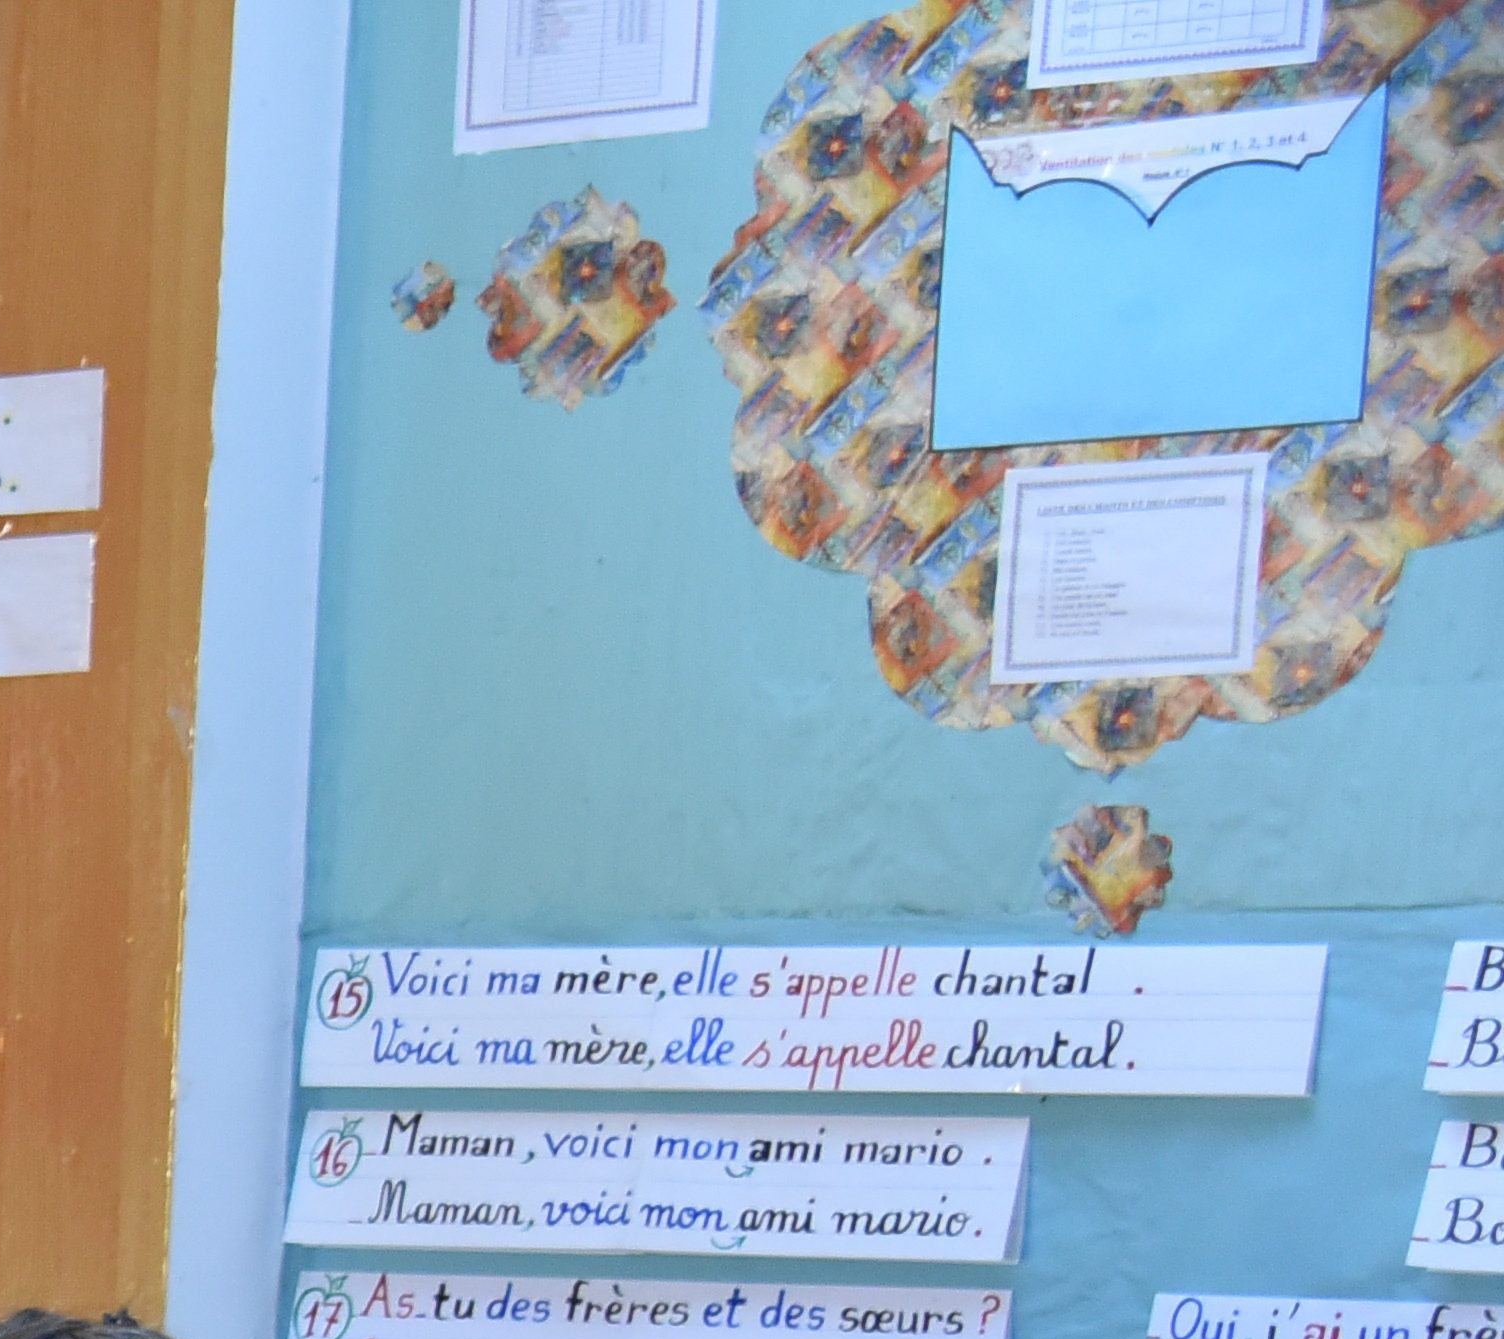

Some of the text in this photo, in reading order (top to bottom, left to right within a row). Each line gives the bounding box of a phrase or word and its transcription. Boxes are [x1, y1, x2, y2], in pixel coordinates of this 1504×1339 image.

[381, 951, 472, 996] Voici
[486, 972, 541, 995] ma
[672, 949, 739, 997] elle
[326, 980, 367, 1020] 15
[372, 1017, 460, 1066] Voici
[476, 1038, 537, 1065] ma
[661, 1017, 735, 1066] elle
[544, 1121, 637, 1158] voici
[654, 1136, 739, 1160] mon
[749, 1126, 826, 1163] ami
[542, 1190, 633, 1227] voici
[640, 1204, 729, 1232] mon
[734, 1198, 816, 1234] ami
[486, 1281, 550, 1322] des
[565, 1282, 691, 1326] frères
[703, 1290, 748, 1328] et
[760, 1288, 826, 1330] des
